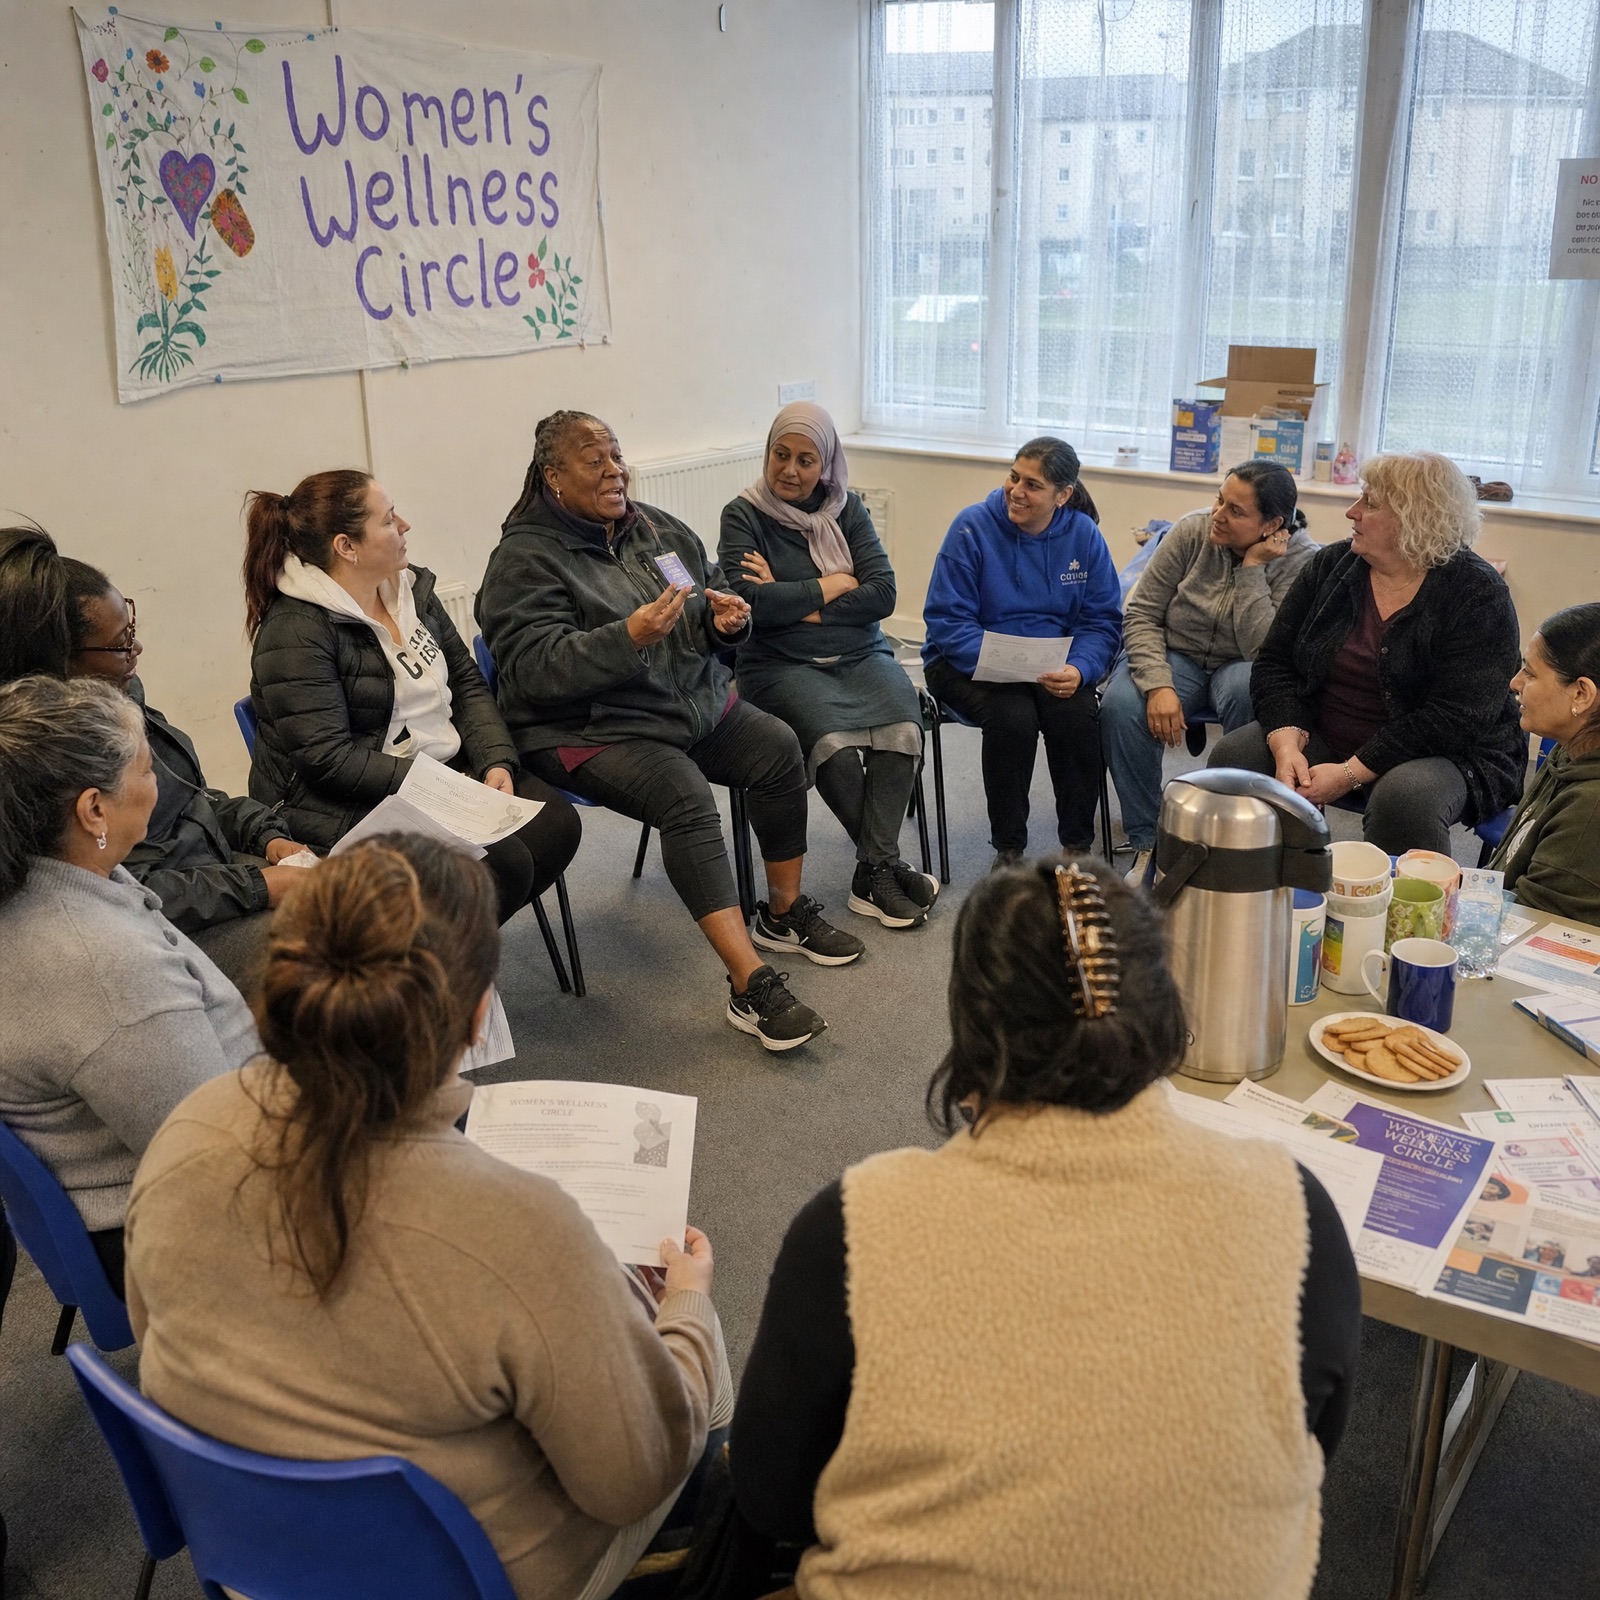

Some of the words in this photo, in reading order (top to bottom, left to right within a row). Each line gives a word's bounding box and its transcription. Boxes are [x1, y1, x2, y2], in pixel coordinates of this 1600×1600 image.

[281, 54, 550, 156] Women's
[1580, 175, 1598, 184] NO
[301, 153, 559, 248] Wellness
[355, 237, 520, 320] Circle
[509, 1098, 555, 1107] WOMEN'S
[556, 1099, 608, 1109] WELLNESS
[540, 1108, 575, 1117] CIRCLE
[1388, 1119, 1473, 1154] WOMEN'S
[1392, 1144, 1457, 1171] CIRCLE
